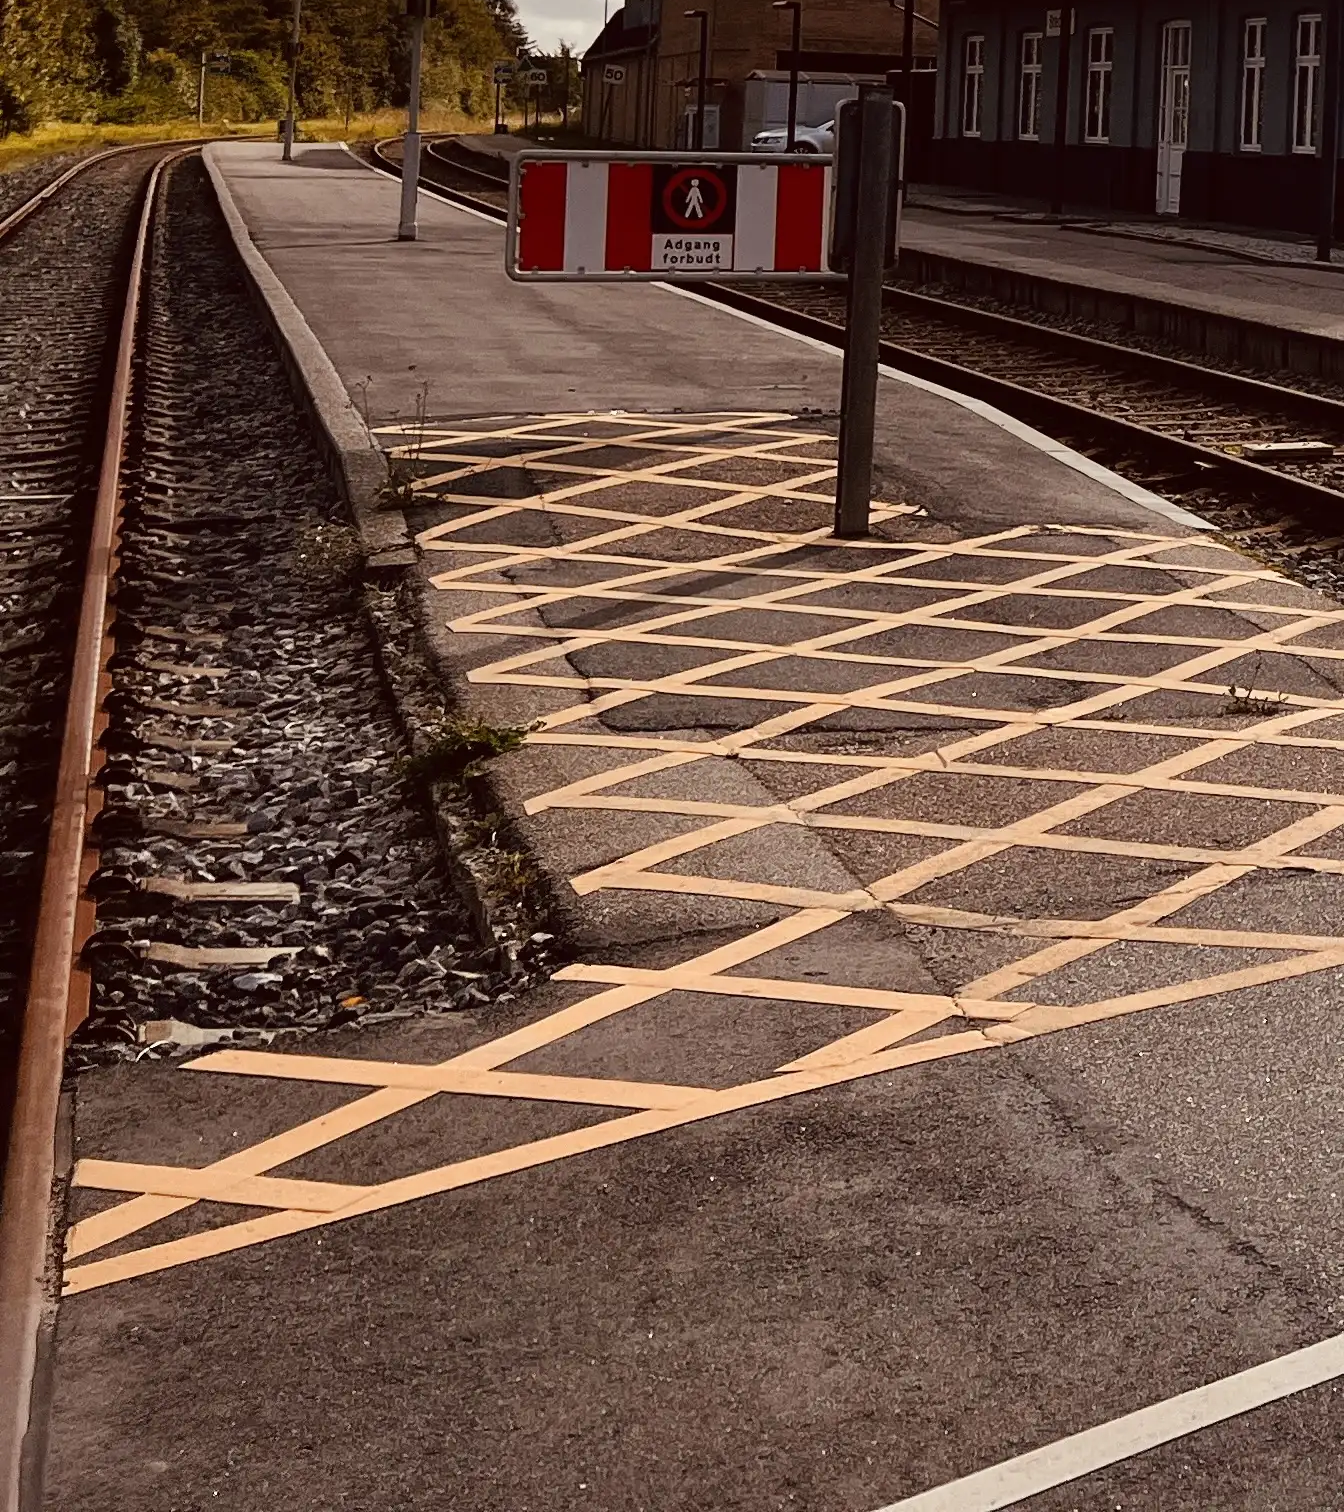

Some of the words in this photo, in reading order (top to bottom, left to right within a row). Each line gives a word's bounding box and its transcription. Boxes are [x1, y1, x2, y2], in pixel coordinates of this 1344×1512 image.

[605, 68, 623, 81] 50
[664, 239, 720, 252] Adgang
[663, 253, 720, 264] forbudt
